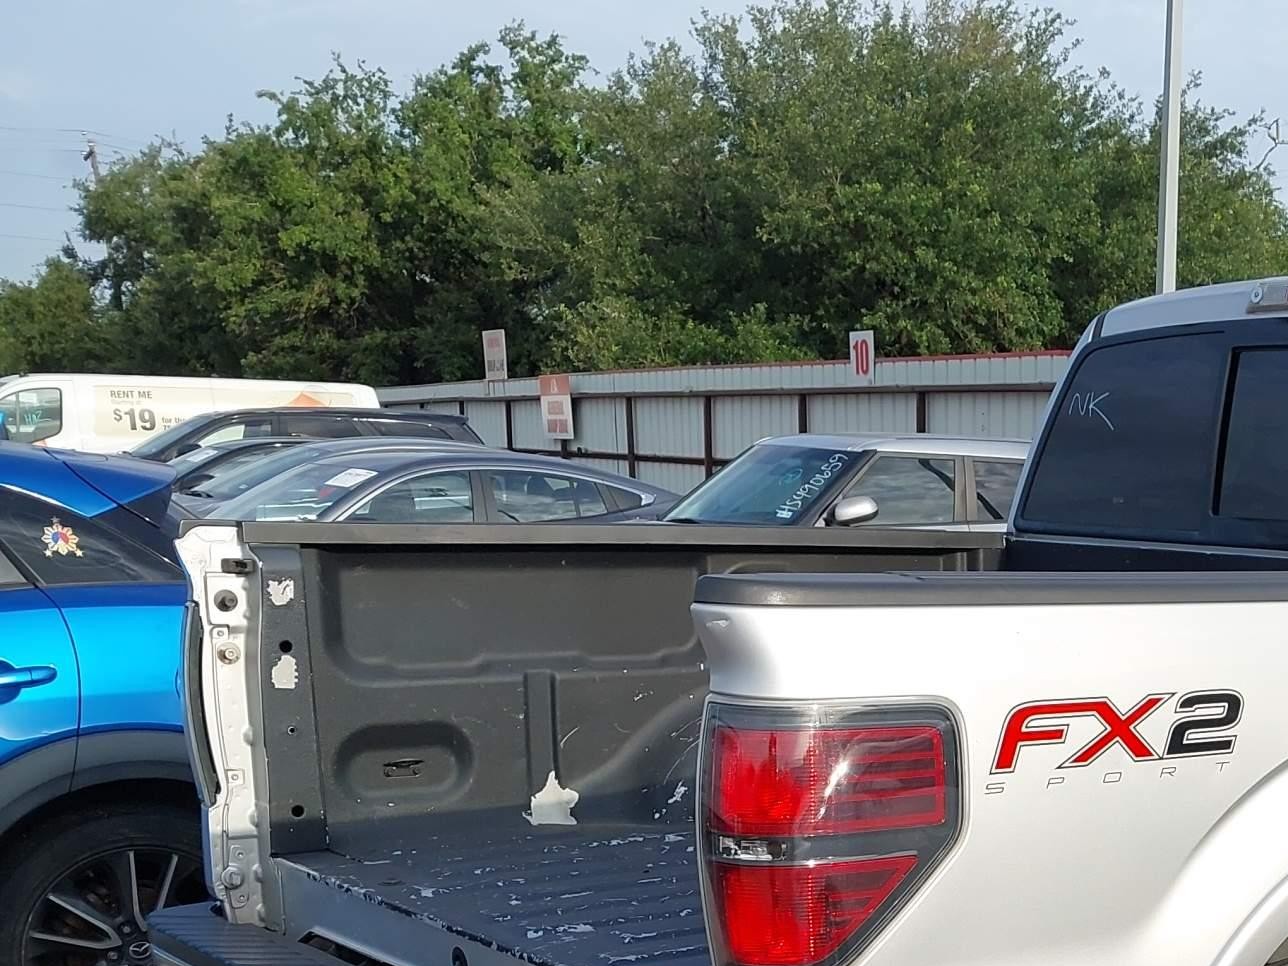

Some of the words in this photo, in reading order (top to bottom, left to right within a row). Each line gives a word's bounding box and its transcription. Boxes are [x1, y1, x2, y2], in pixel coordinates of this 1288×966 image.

[853, 339, 869, 375] 10
[110, 390, 135, 399] RENT
[138, 390, 153, 399] ME
[1069, 392, 1114, 430] NK
[113, 408, 156, 431] $19
[989, 688, 1244, 775] FX2
[984, 761, 1231, 794] SPORT
